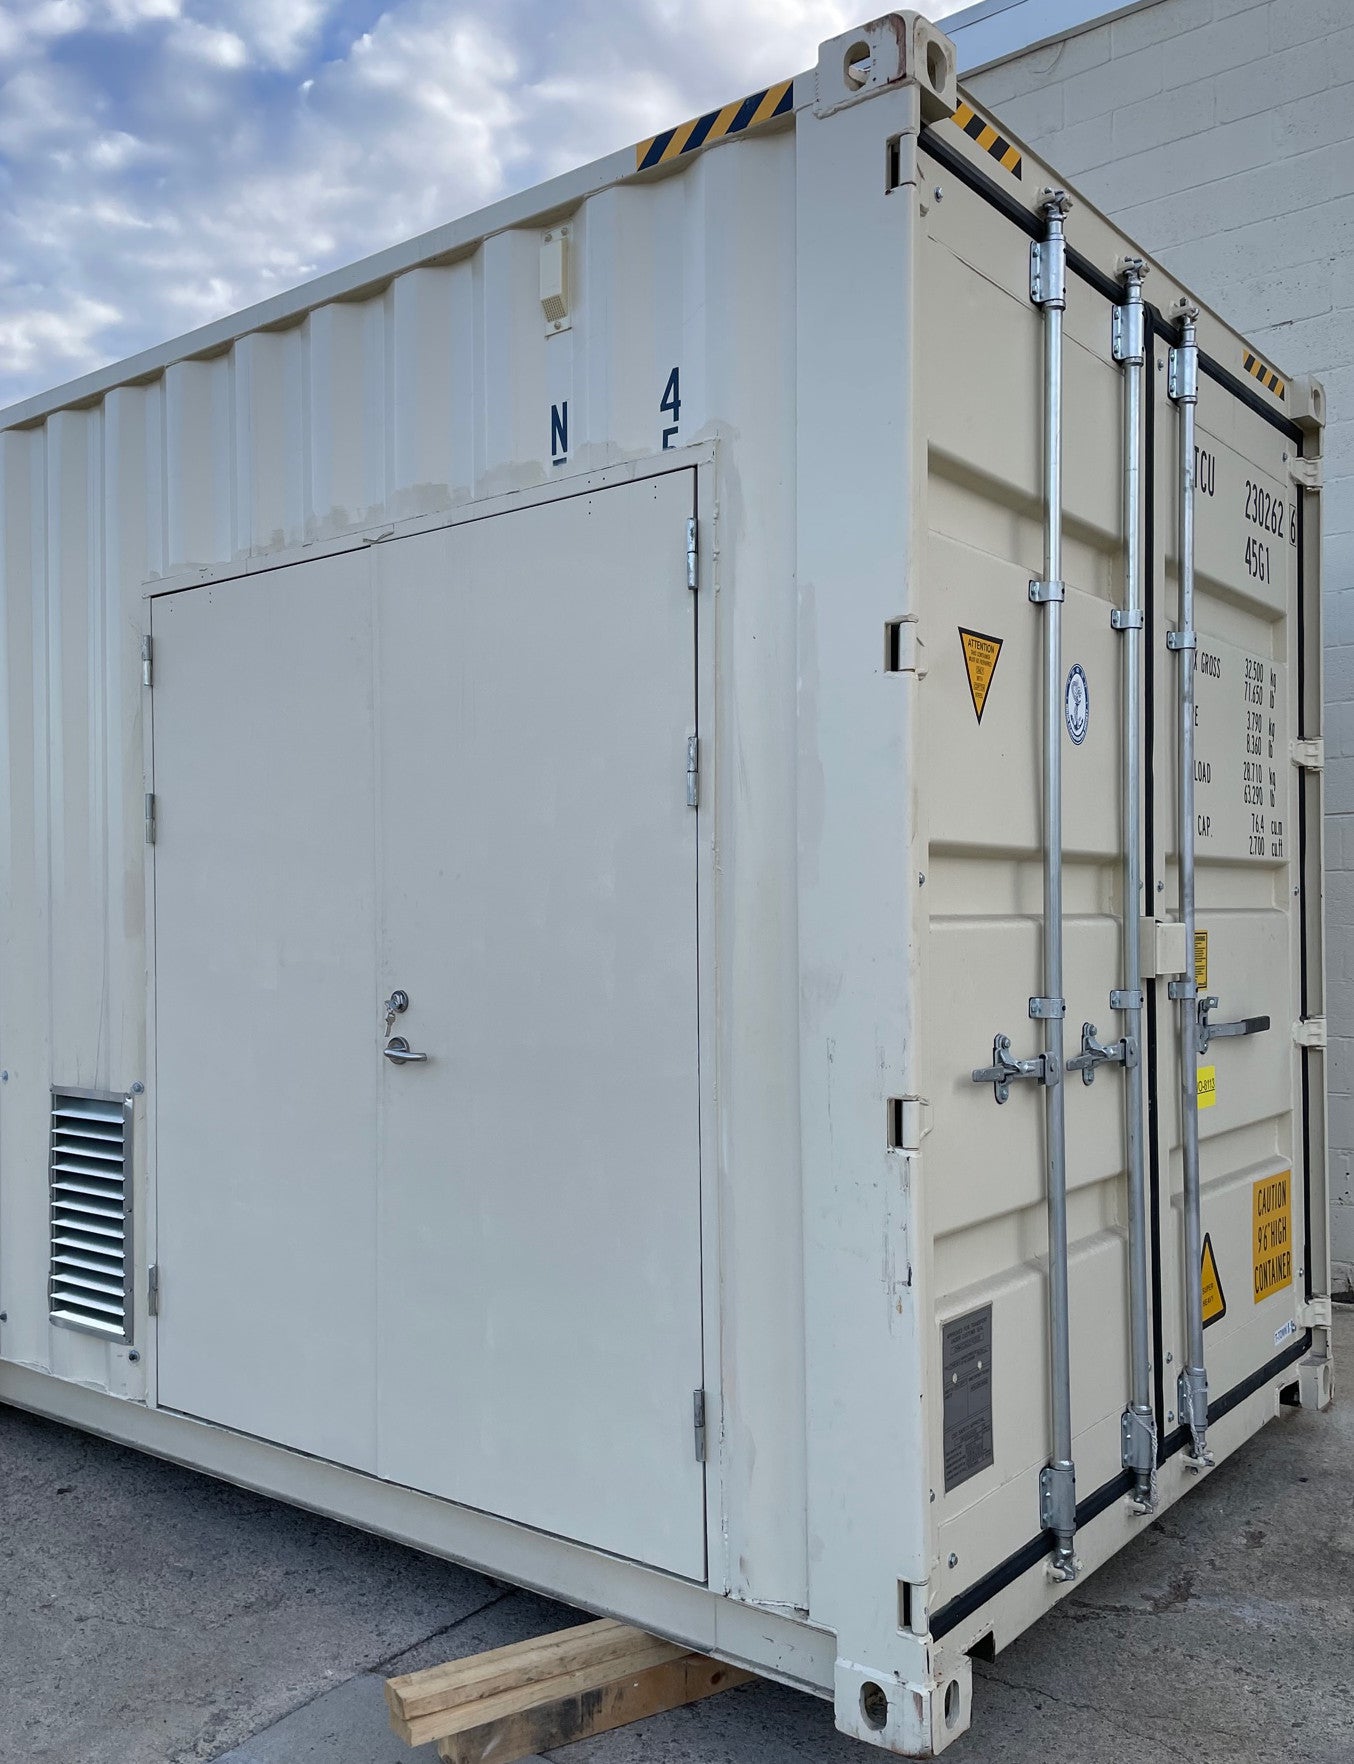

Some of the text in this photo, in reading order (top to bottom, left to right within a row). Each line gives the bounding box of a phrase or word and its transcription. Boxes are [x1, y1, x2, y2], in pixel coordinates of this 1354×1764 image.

[660, 366, 681, 422] 4
[551, 400, 568, 456] N
[1245, 480, 1284, 538] 230262
[1290, 509, 1296, 544] 6
[1245, 536, 1270, 585] 45G1
[967, 638, 995, 654] ATTENTION
[1201, 651, 1220, 679] GROSS
[1245, 657, 1264, 683] 32.500
[1270, 667, 1277, 694] kg
[1268, 716, 1276, 743] kg
[1268, 766, 1276, 792] kg
[1197, 814, 1213, 838] CAP.
[1257, 1179, 1287, 1217] CAUTION
[1254, 1250, 1291, 1294] CONTAINER
